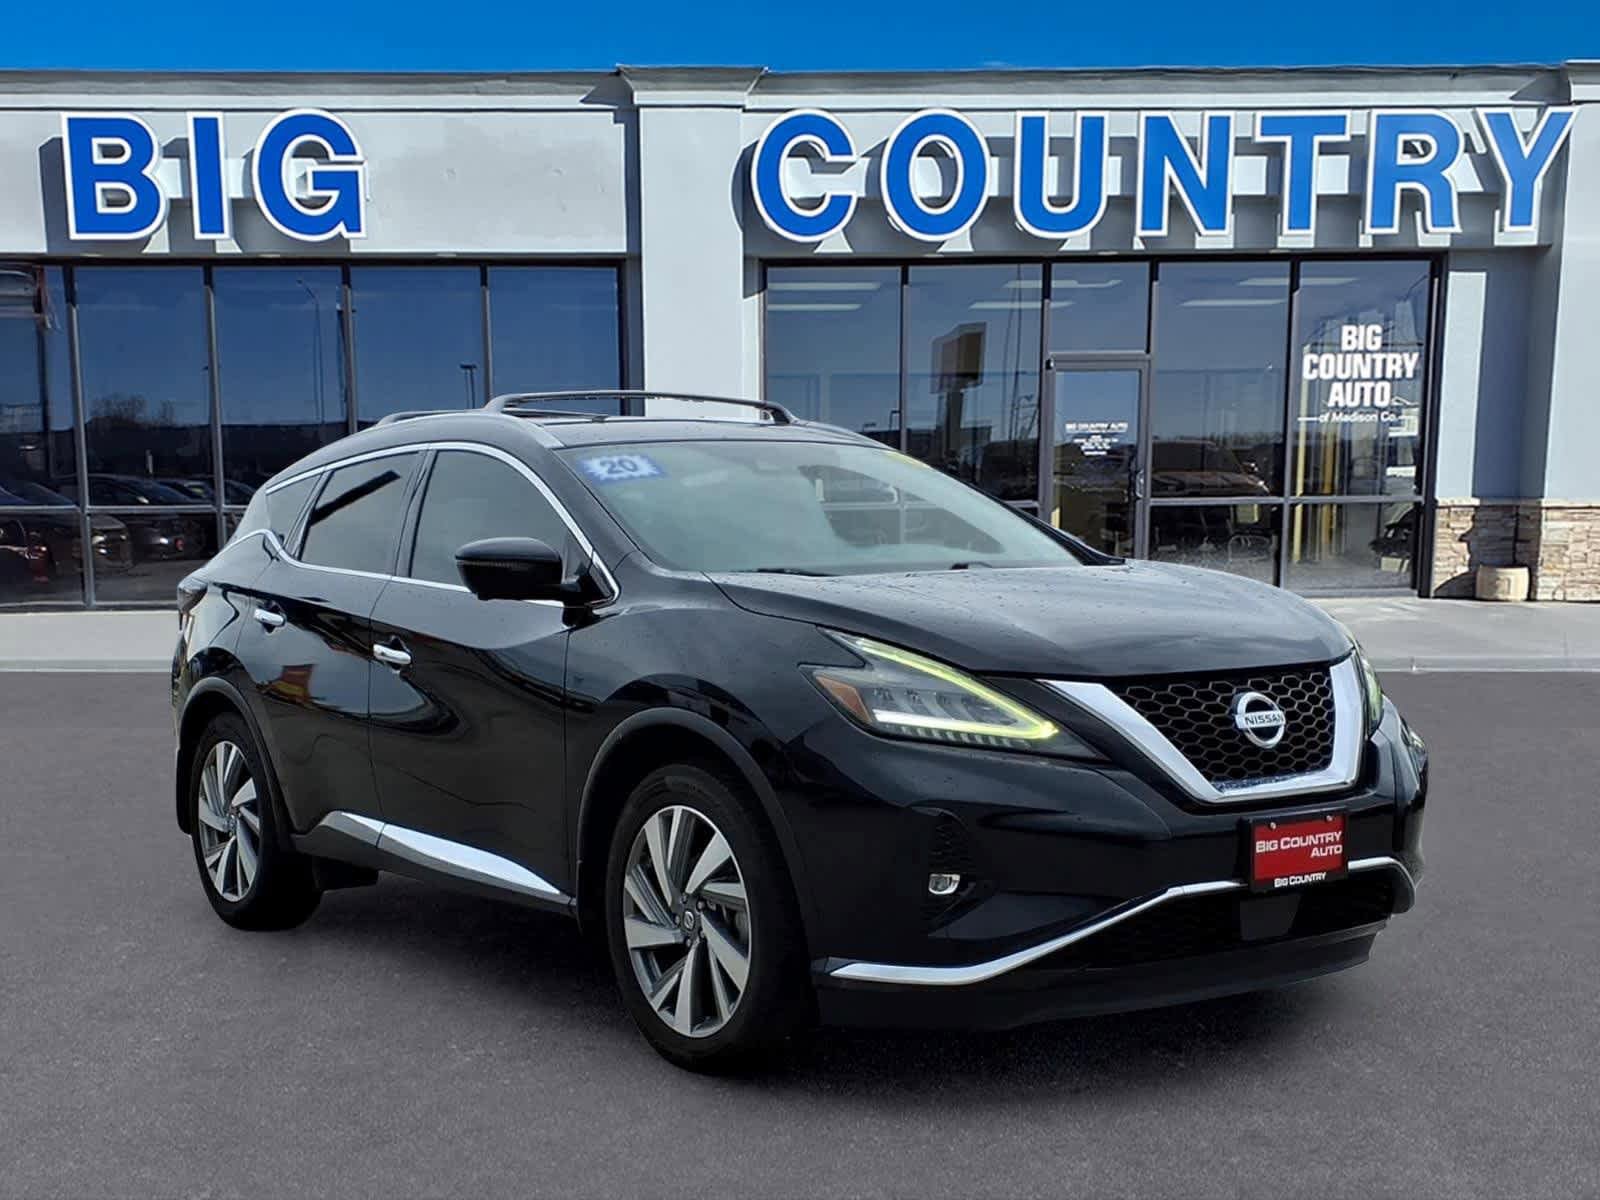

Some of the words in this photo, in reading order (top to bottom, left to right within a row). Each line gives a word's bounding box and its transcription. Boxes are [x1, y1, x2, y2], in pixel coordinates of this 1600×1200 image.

[60, 108, 366, 242] BIG
[751, 106, 1580, 242] COUNTRY
[1341, 324, 1383, 351] BIG
[1303, 352, 1419, 379] COUNTRY
[1327, 381, 1391, 407] AUTO
[1331, 411, 1378, 422] Madison
[600, 458, 638, 475] 20
[1245, 713, 1284, 725] NISSAN
[1256, 839, 1279, 853] BIG
[1280, 831, 1343, 850] COUNTRY
[1310, 844, 1343, 858] AUTO
[1274, 877, 1288, 888] BIG
[1289, 872, 1327, 885] COUNTRY
